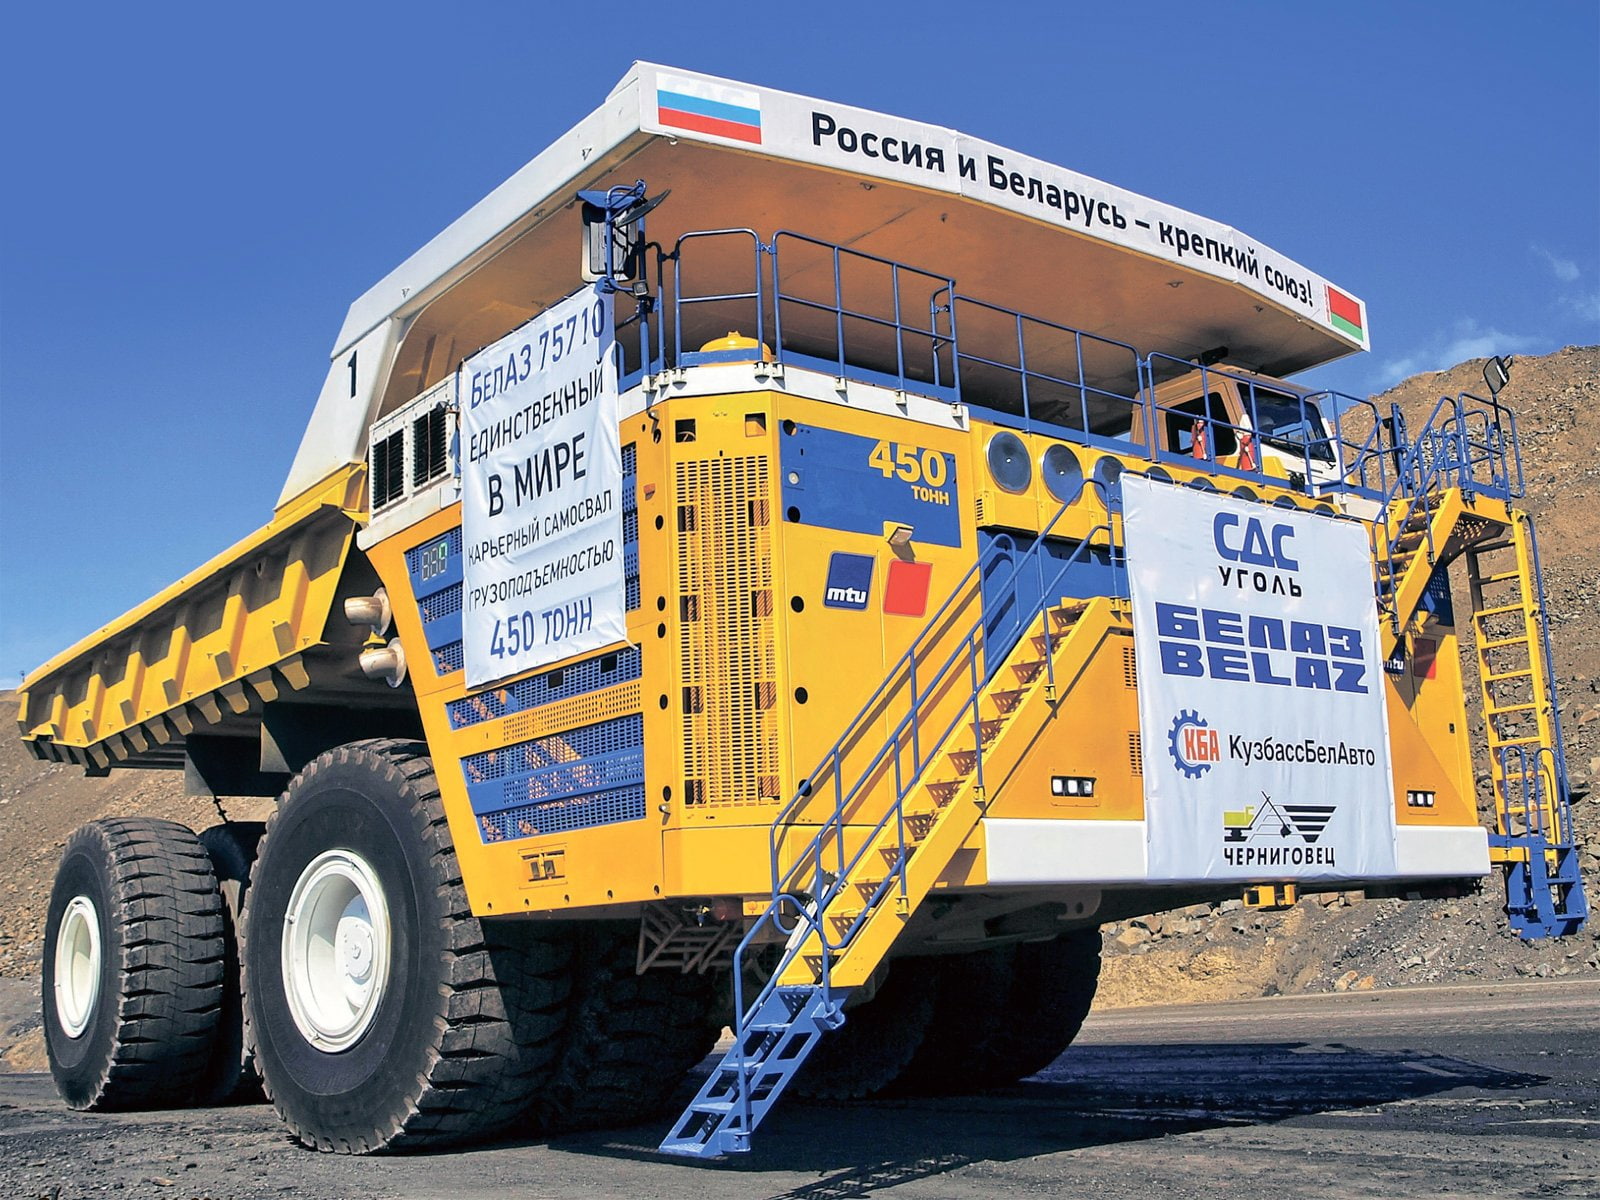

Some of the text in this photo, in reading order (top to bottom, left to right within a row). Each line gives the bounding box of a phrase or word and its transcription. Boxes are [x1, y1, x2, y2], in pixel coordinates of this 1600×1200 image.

[811, 110, 945, 173] Россия
[958, 153, 977, 182] и
[987, 155, 1128, 230] Беларусь
[1158, 220, 1259, 279] крепкий
[1264, 264, 1314, 308] союз!
[538, 299, 606, 374] 75710
[347, 350, 358, 399] 1
[469, 357, 604, 465] ЕДИНСТВЕННЫЙ
[488, 431, 587, 518] В МИРЕ
[868, 440, 947, 487] 450
[911, 485, 950, 506] ТОНН
[468, 489, 613, 568] КАРЬЕРНЫЙ САМОСВАЛ
[468, 539, 615, 612] ГРУЗОПОДЪЕМНОСТЬЮ
[826, 587, 867, 603] mtu
[1218, 565, 1302, 598] УГОЛЬ
[490, 596, 593, 659] 450 ТОНН
[1155, 601, 1365, 661] БЕЛАЗ
[1158, 640, 1369, 694] BELAZ
[1183, 728, 1220, 762] КБА
[1229, 735, 1376, 767] КузбассБелАвто
[1223, 847, 1336, 867] ЧЕРНИГОВЕЦ
